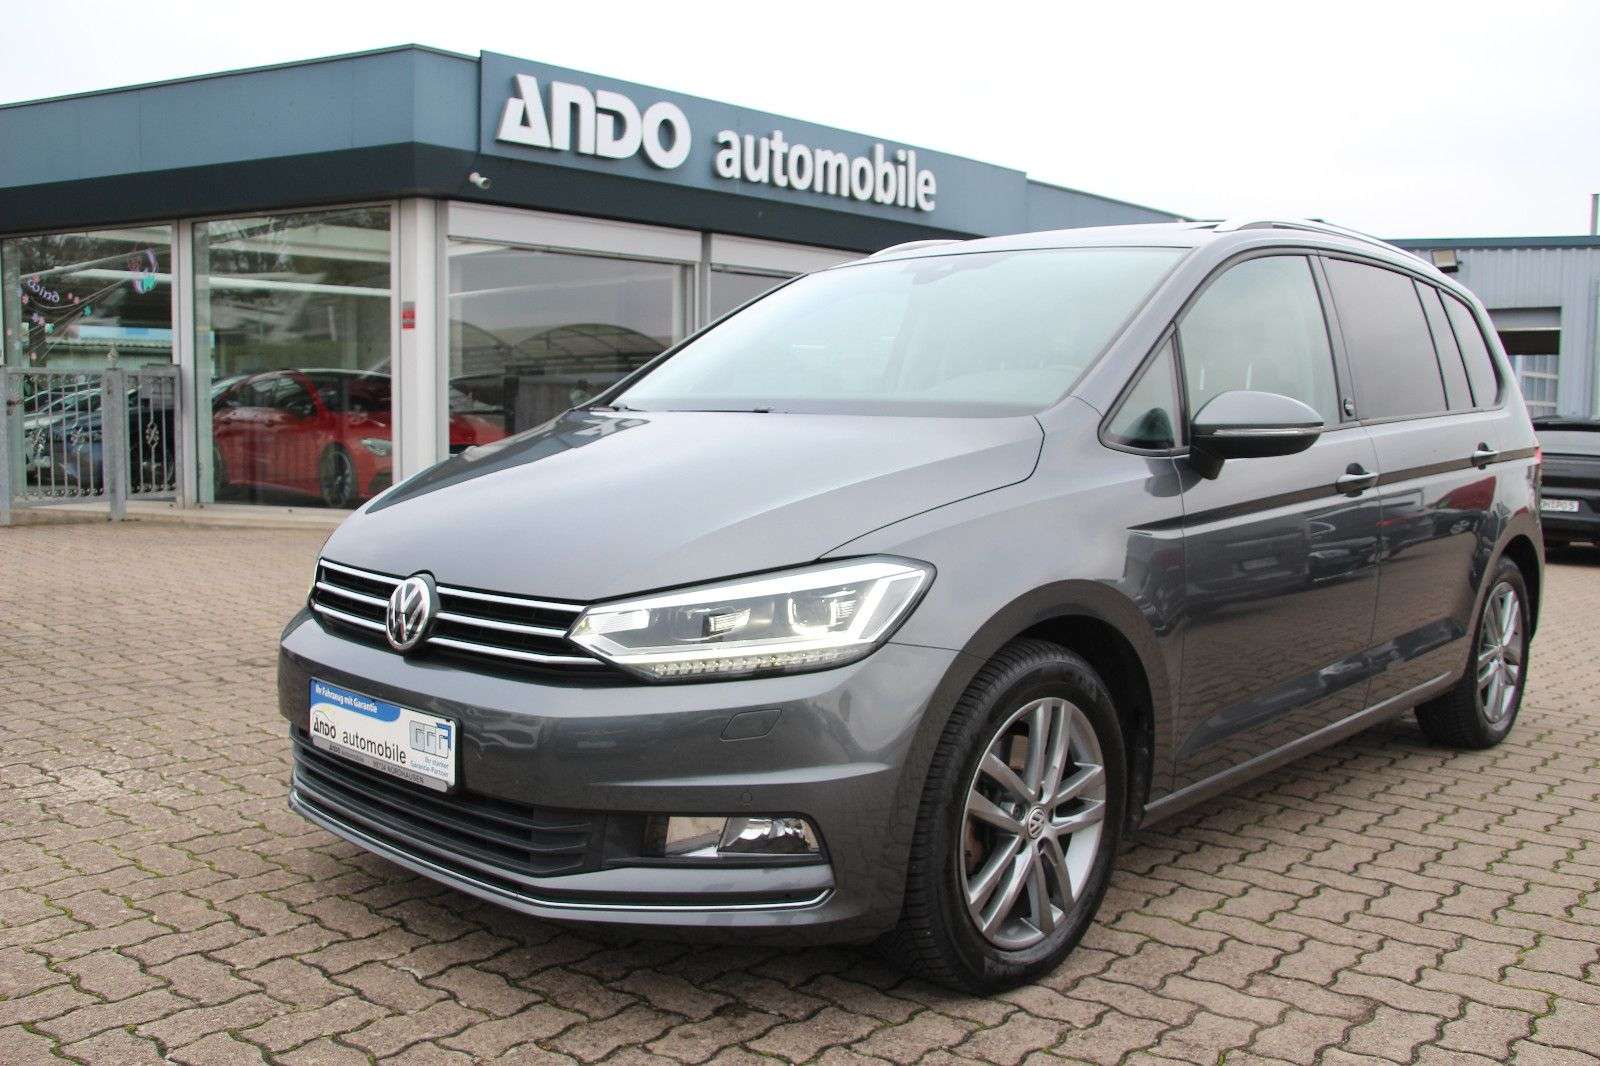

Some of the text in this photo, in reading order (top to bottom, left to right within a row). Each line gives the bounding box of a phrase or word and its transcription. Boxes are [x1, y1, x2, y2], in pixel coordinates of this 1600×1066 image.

[496, 74, 936, 212] ANDO automobile
[323, 687, 344, 705] Fahrzeug
[342, 731, 407, 764] automobile
